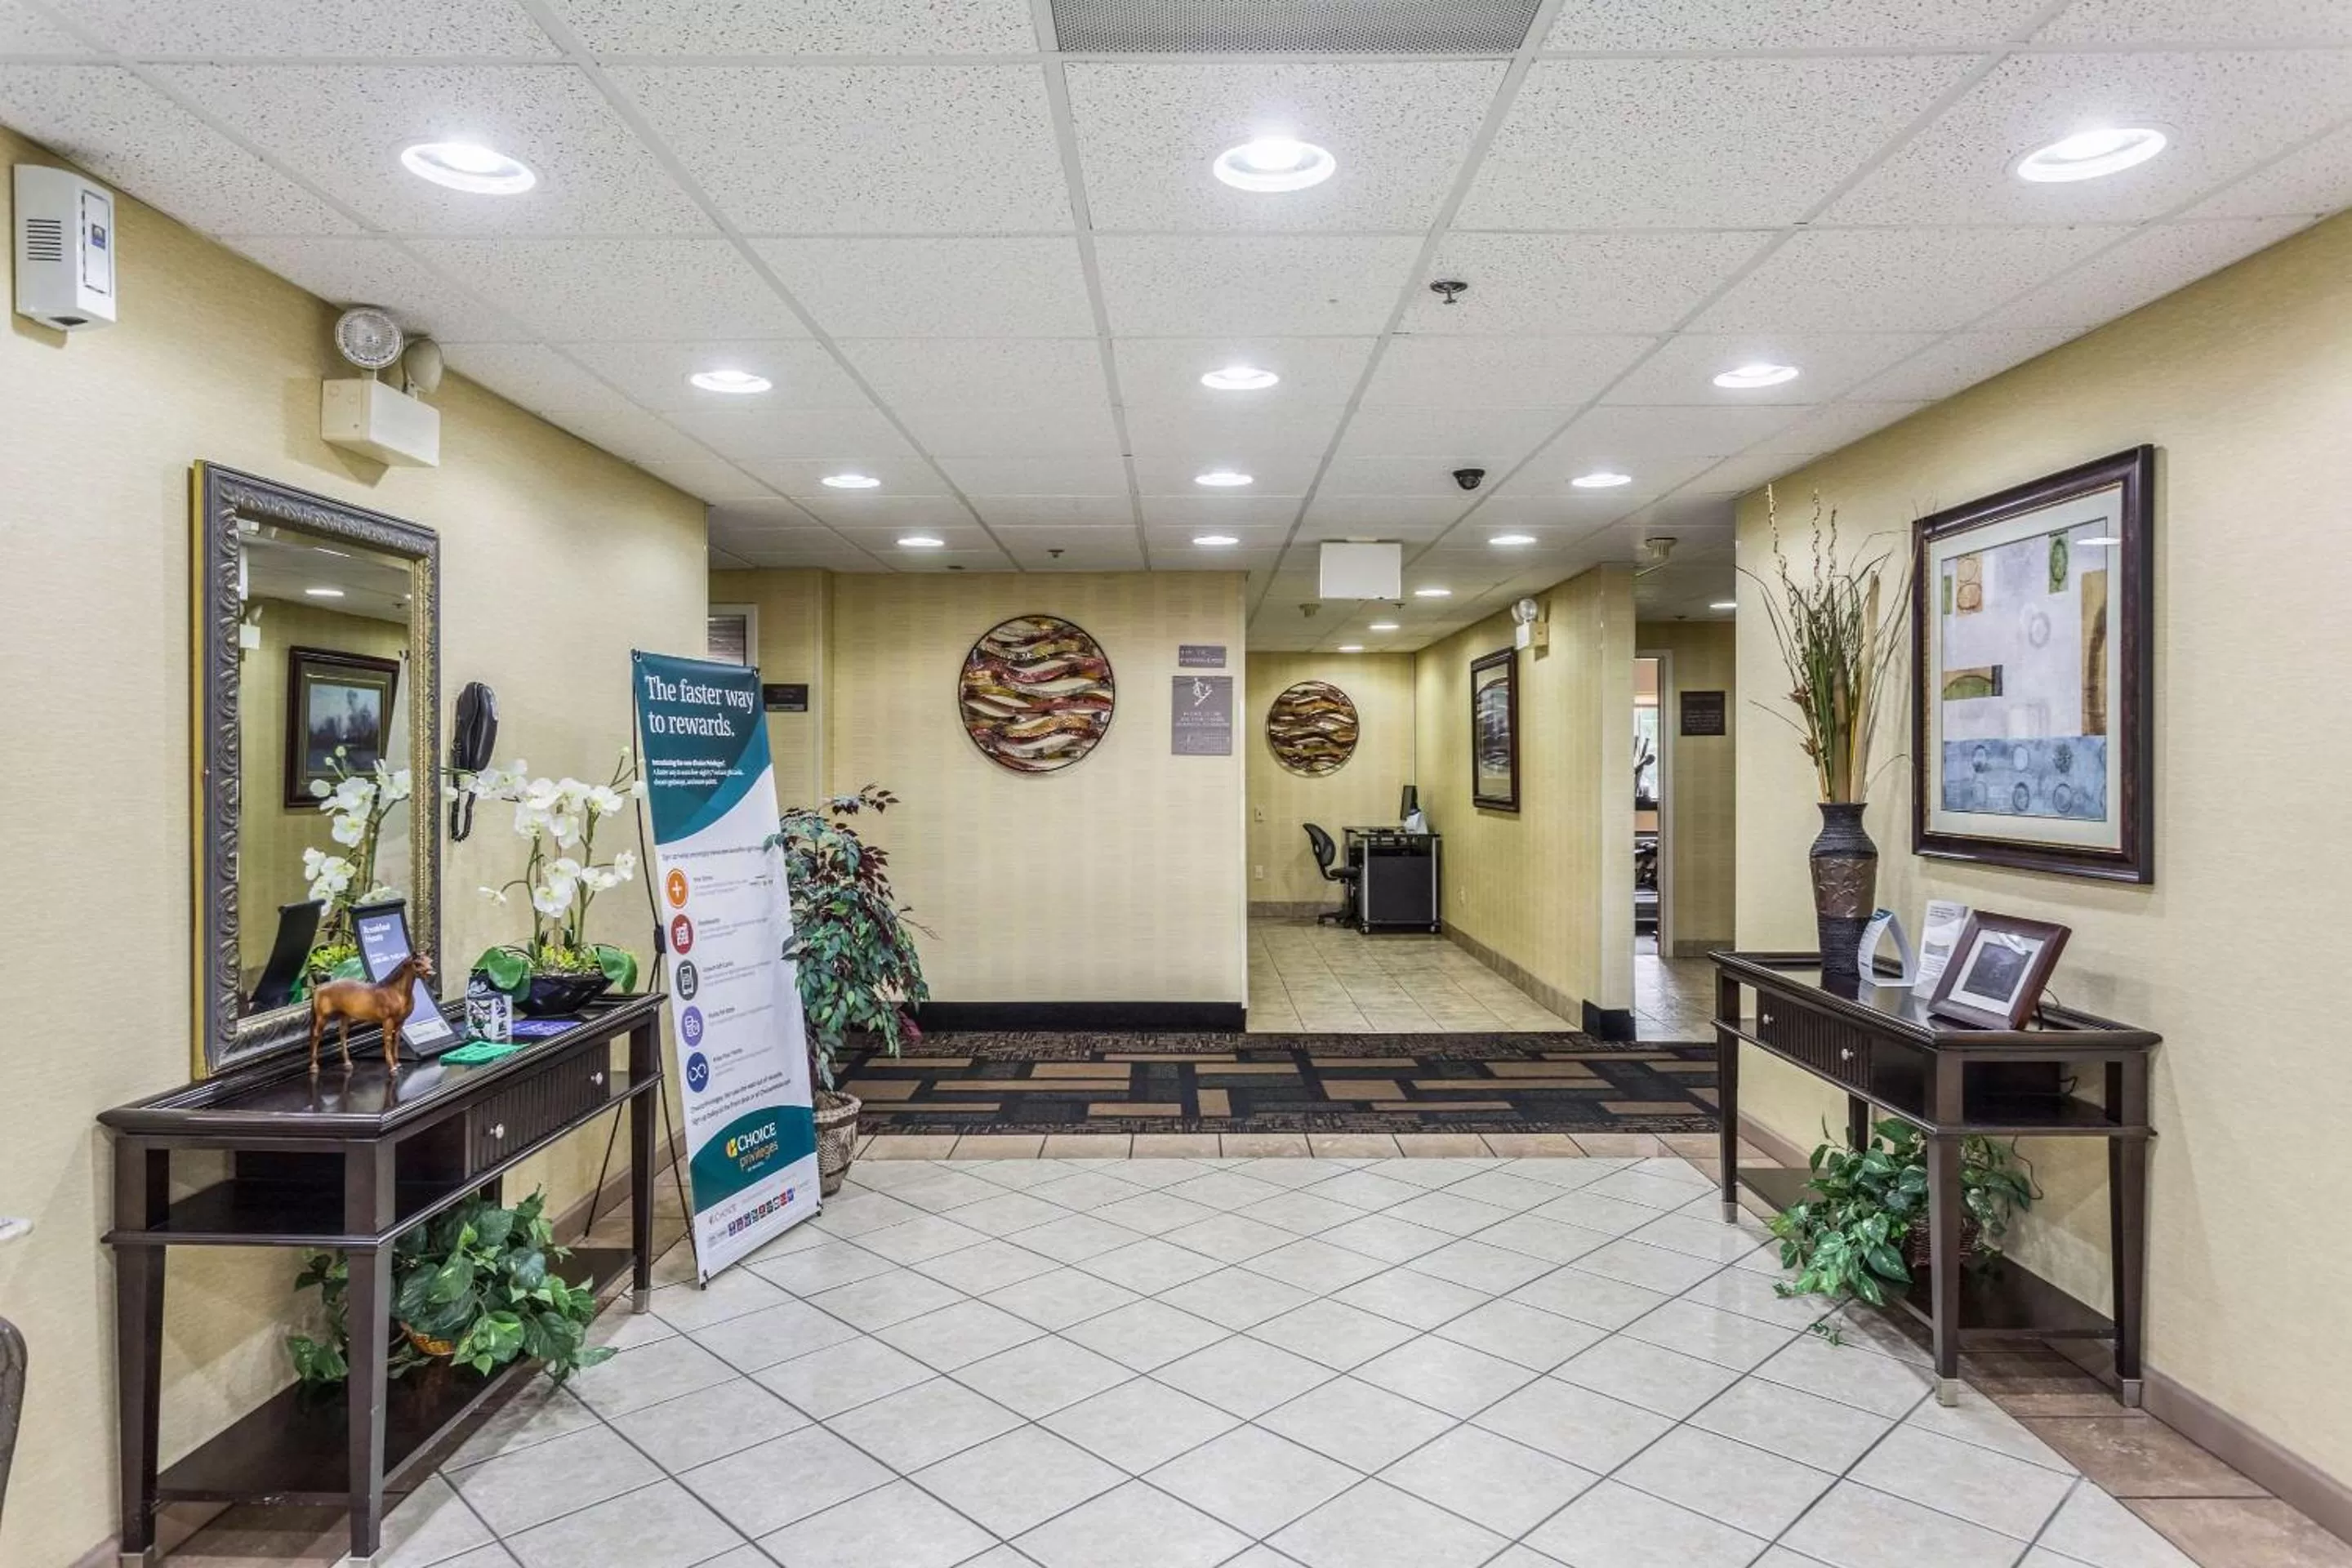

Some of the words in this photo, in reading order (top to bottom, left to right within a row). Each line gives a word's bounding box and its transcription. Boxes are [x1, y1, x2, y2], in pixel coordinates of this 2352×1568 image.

[645, 675, 676, 702] The
[679, 679, 722, 706] faster
[725, 689, 755, 714] way
[648, 713, 666, 733] to
[668, 713, 735, 737] rewards.
[737, 1122, 777, 1152] CHOICE
